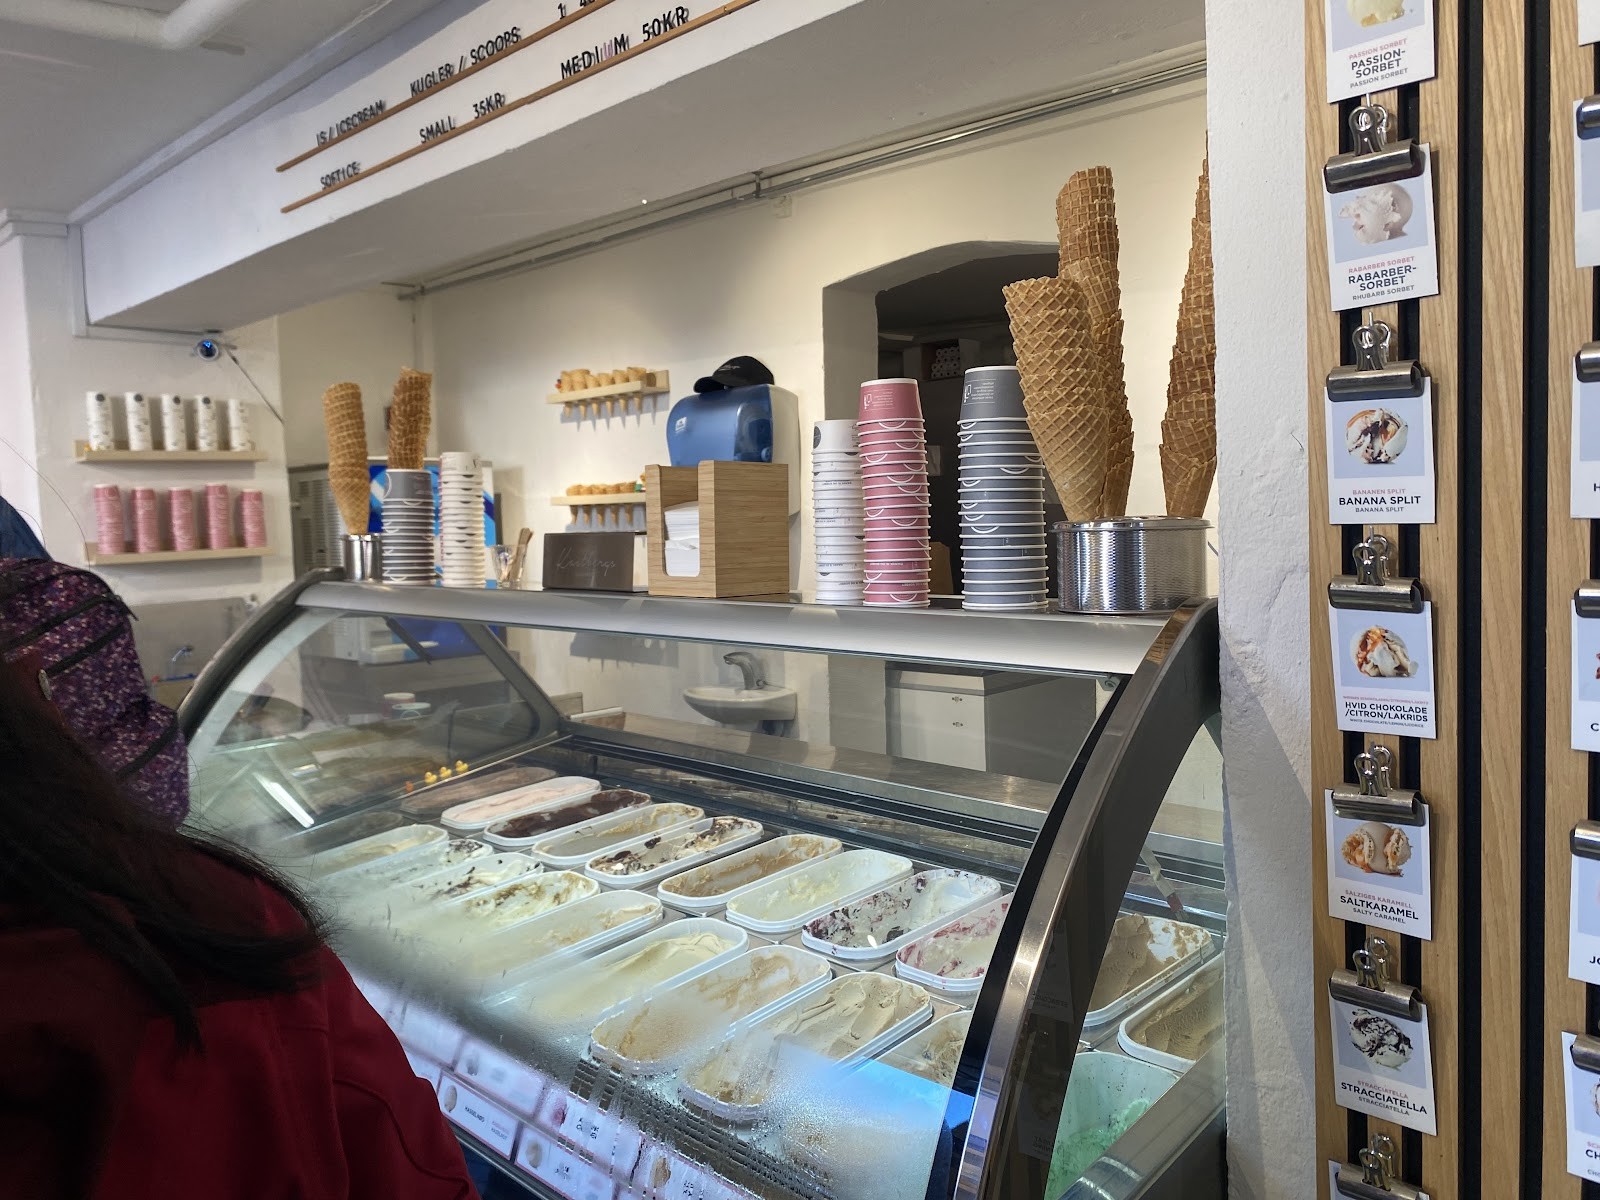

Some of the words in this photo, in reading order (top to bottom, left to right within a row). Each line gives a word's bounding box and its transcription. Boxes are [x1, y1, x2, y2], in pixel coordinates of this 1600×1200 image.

[1349, 47, 1378, 60] PASSION
[1379, 38, 1407, 51] SORBET
[410, 63, 453, 98] KUGLER
[470, 26, 519, 66] SCOOPS
[1351, 48, 1406, 71] PASSION-
[1355, 57, 1402, 79] SORBET
[1350, 76, 1380, 89] PASSION
[1380, 67, 1409, 79] SORBET
[320, 161, 360, 190] SOFTICE
[419, 115, 456, 144] SMALL
[473, 92, 503, 120] 35KR
[561, 33, 627, 80] MEDIUM
[642, 6, 687, 42] 50KR
[1348, 261, 1386, 274] RABARBER
[1387, 256, 1415, 266] SORBET
[1348, 264, 1417, 285] RABARBER-
[1360, 275, 1406, 291] SORBET
[1352, 290, 1386, 301] RHUBARB
[1387, 285, 1415, 295] SORBET
[1339, 497, 1387, 506] BANANA
[1390, 495, 1421, 505] SPLIT
[1344, 708, 1428, 722] /CITRON/LAKRIDS
[1345, 701, 1367, 710] HVID
[1369, 703, 1428, 715] CHOKOLADE
[1340, 895, 1419, 920] SALTKARAMEL
[1377, 896, 1413, 909] KARAMELL
[1353, 907, 1373, 916] SALTY
[1374, 912, 1406, 924] CARAMEL
[1341, 1082, 1428, 1115] STRACCIATELLA
[1357, 1080, 1409, 1099] STRACCIATELLA
[1358, 1097, 1410, 1116] STRACCIATELLA
